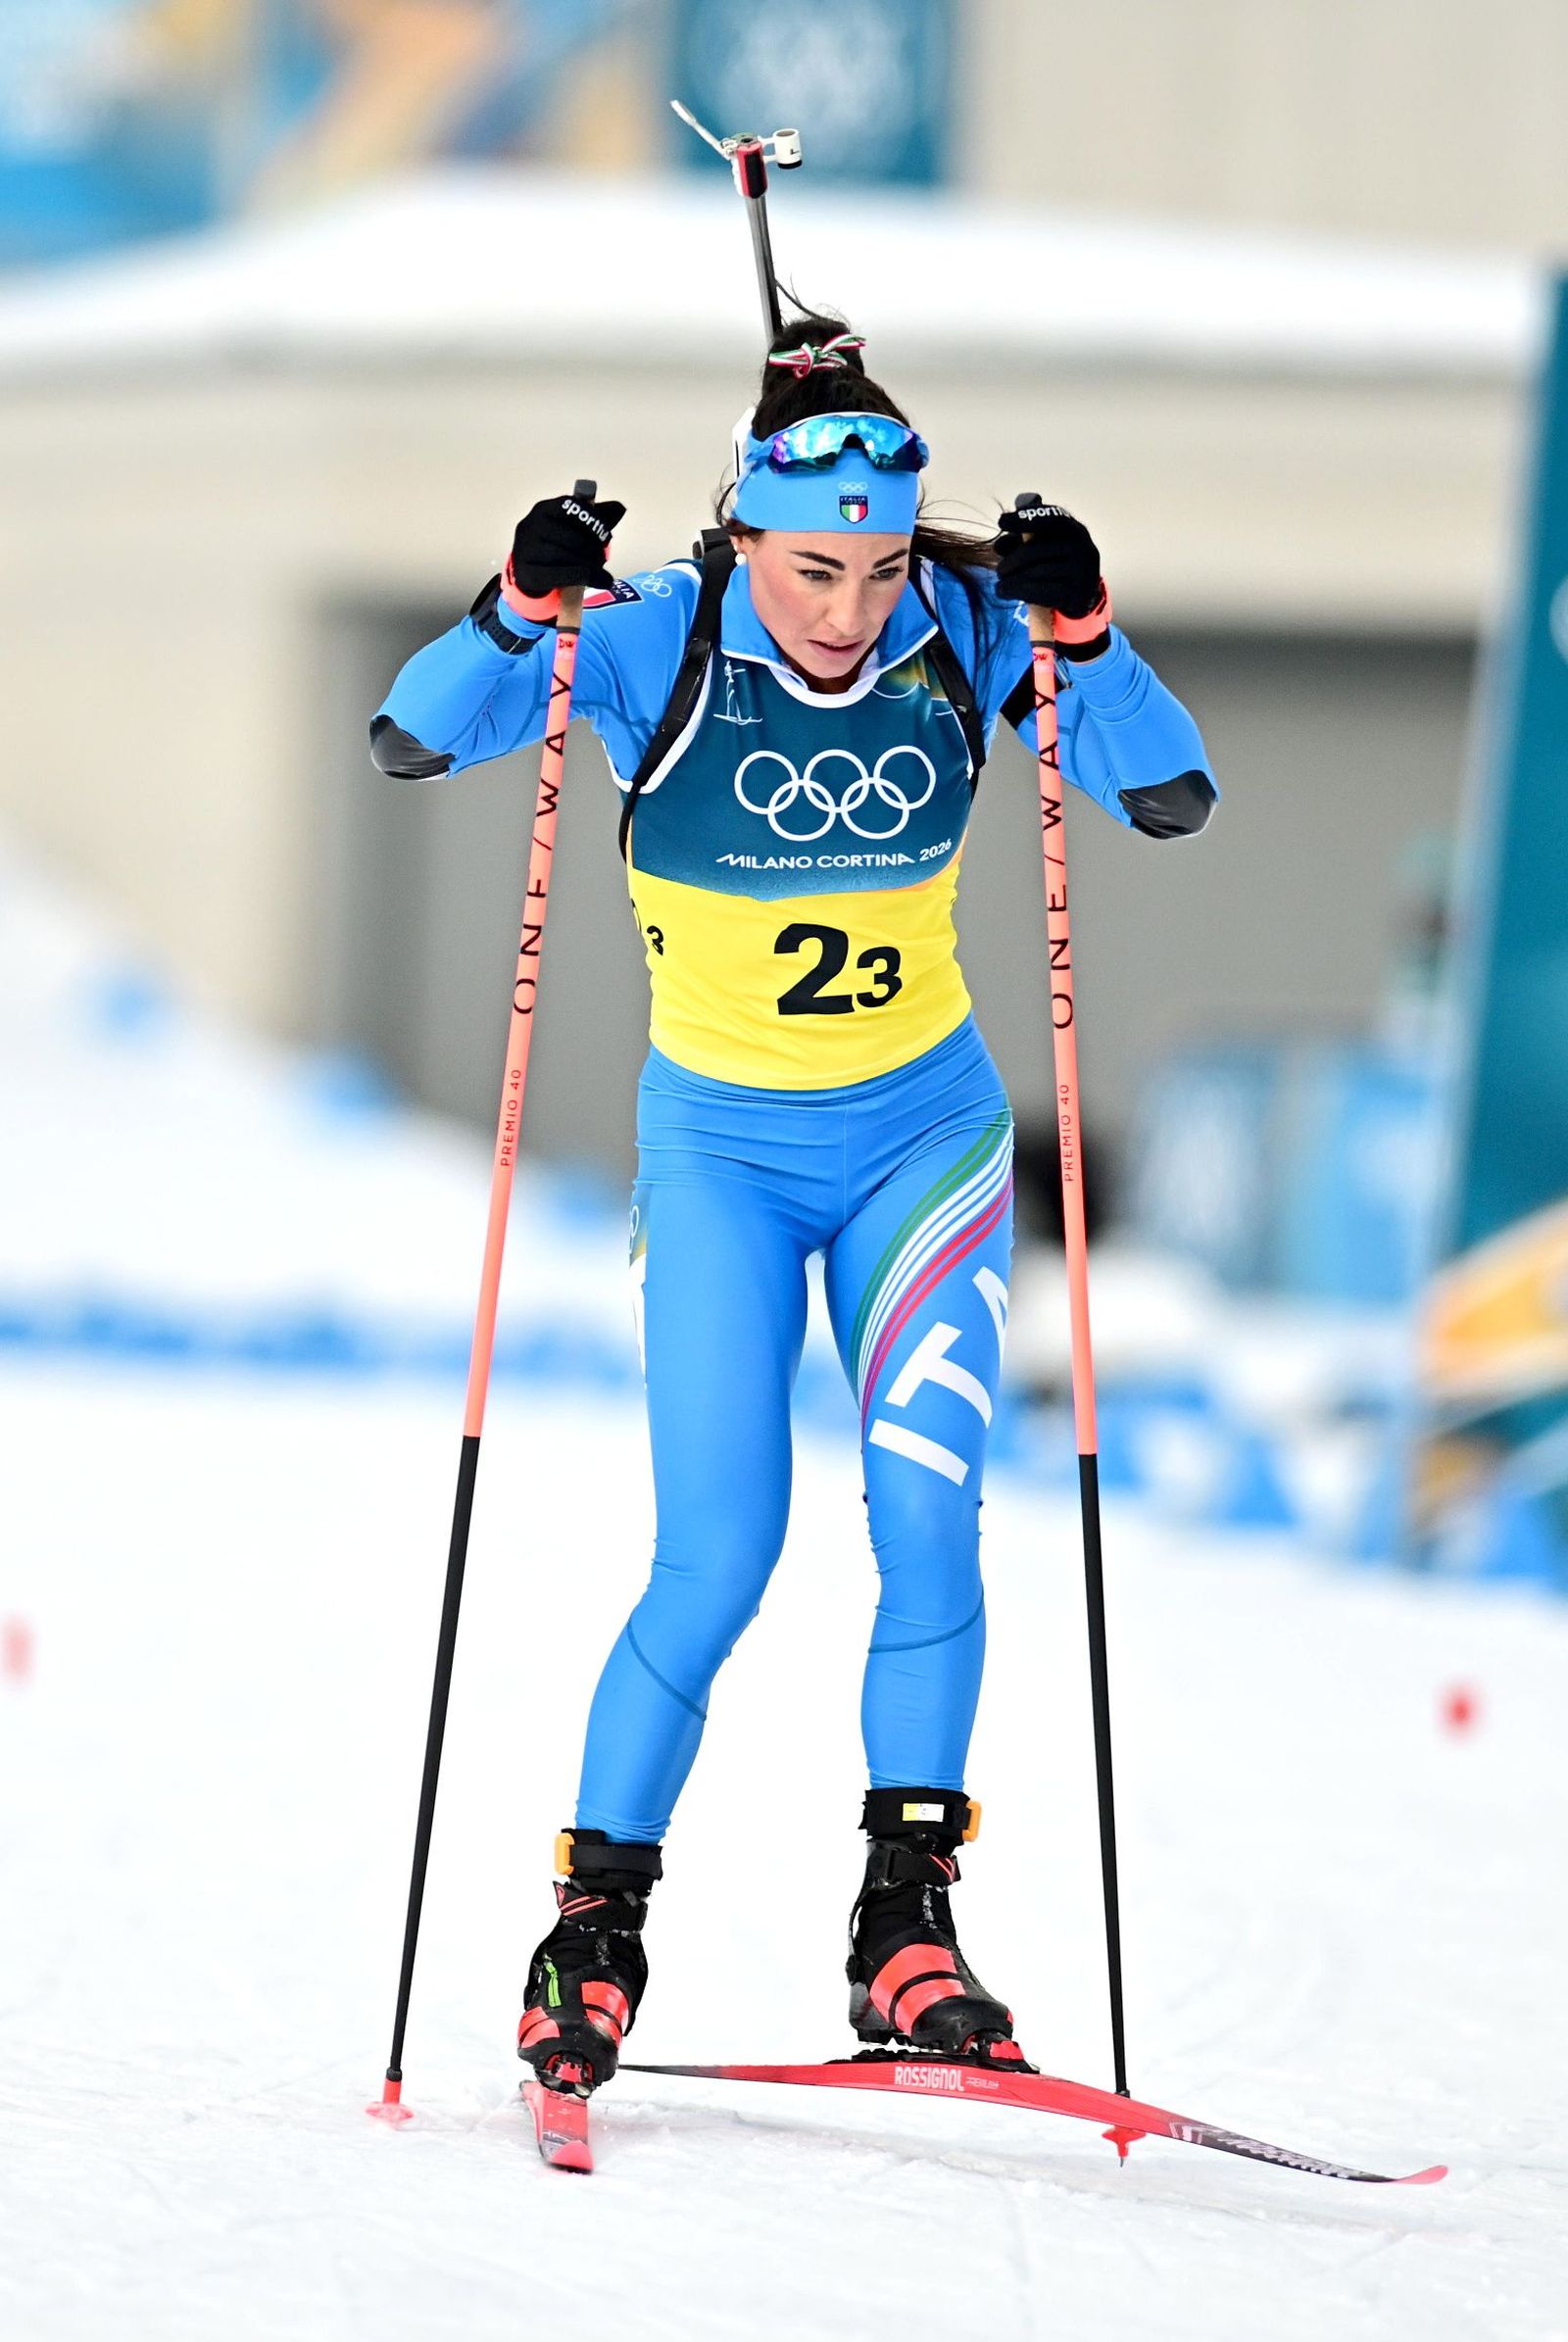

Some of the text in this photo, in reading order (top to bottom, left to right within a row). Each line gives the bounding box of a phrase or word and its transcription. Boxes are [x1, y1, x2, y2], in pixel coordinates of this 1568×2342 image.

[715, 838, 953, 870] MILANO CORTINA 2026
[501, 1069, 522, 1167] PREMIO 40
[1058, 1084, 1075, 1182] PREMIO 40
[894, 2066, 966, 2093] ROSSIGNOL
